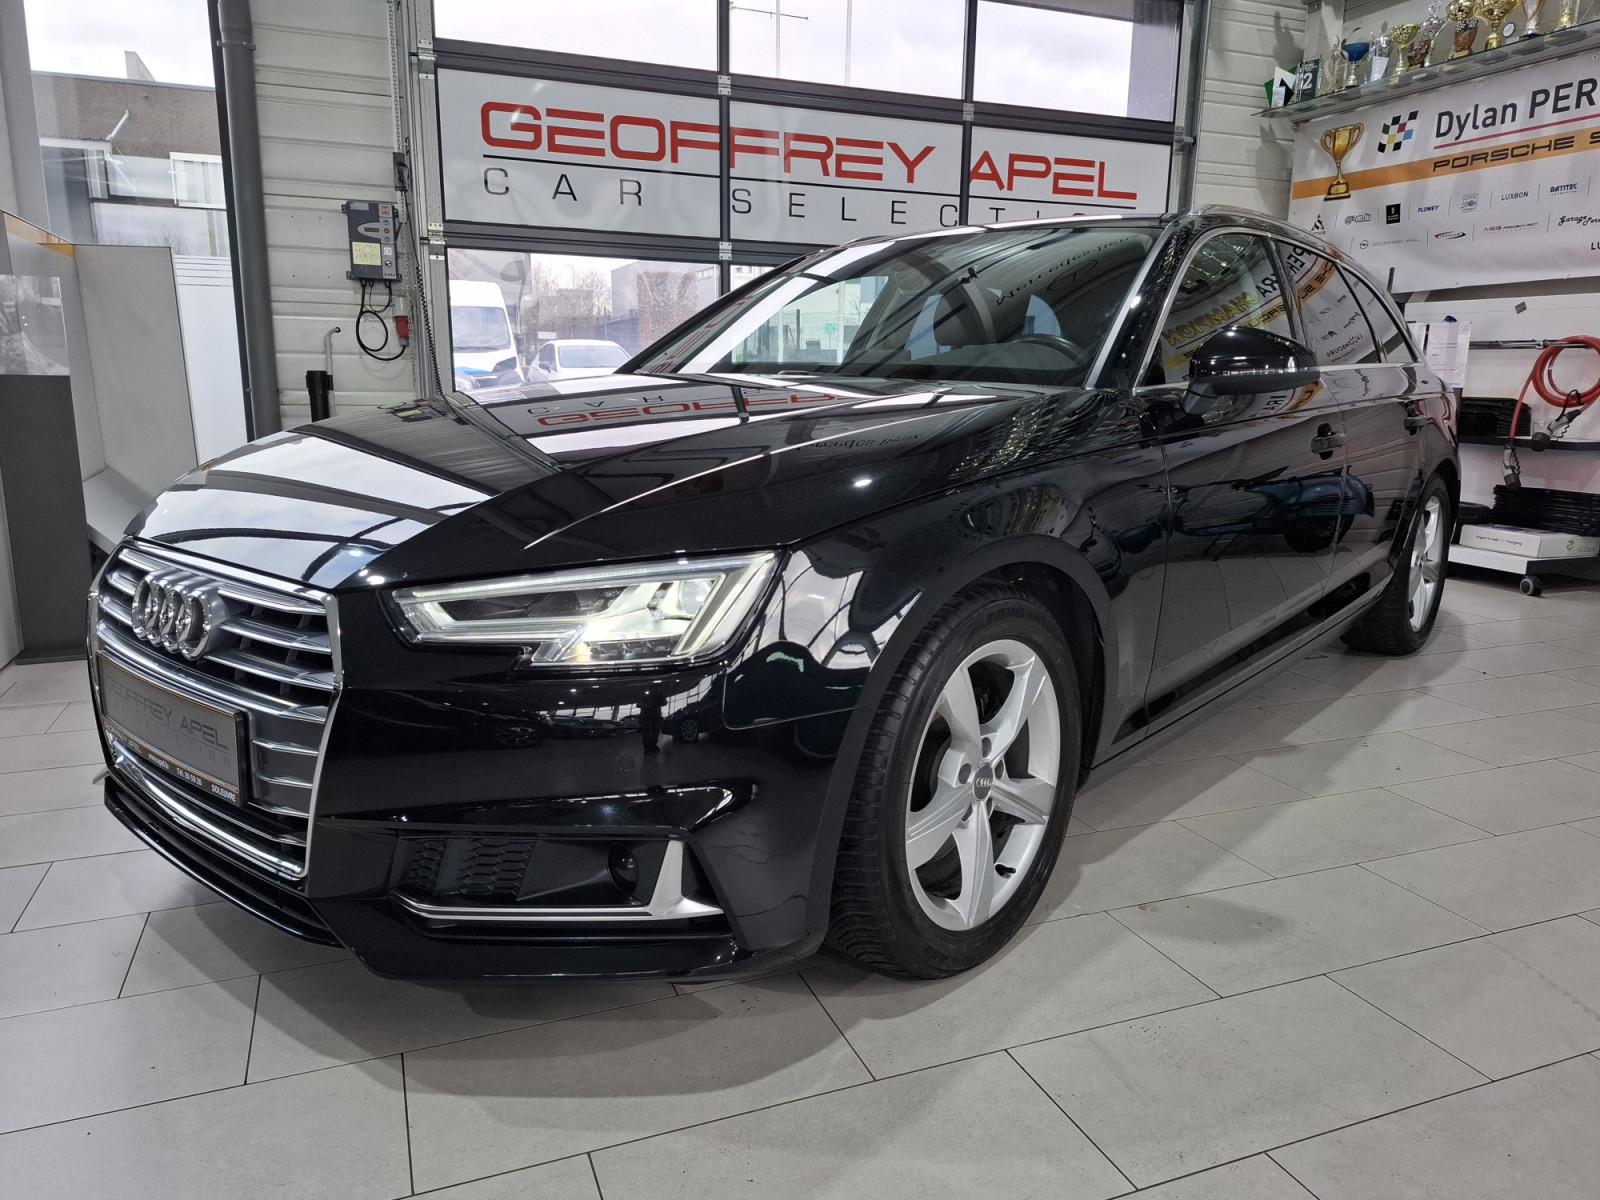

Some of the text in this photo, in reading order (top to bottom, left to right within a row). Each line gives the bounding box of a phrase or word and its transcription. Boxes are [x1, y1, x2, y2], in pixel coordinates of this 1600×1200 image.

[1435, 101, 1518, 140] Dylan
[480, 101, 1137, 200] GEOFFREY APEL
[1433, 136, 1575, 172] PORSCHE
[732, 187, 1087, 228] SELECT
